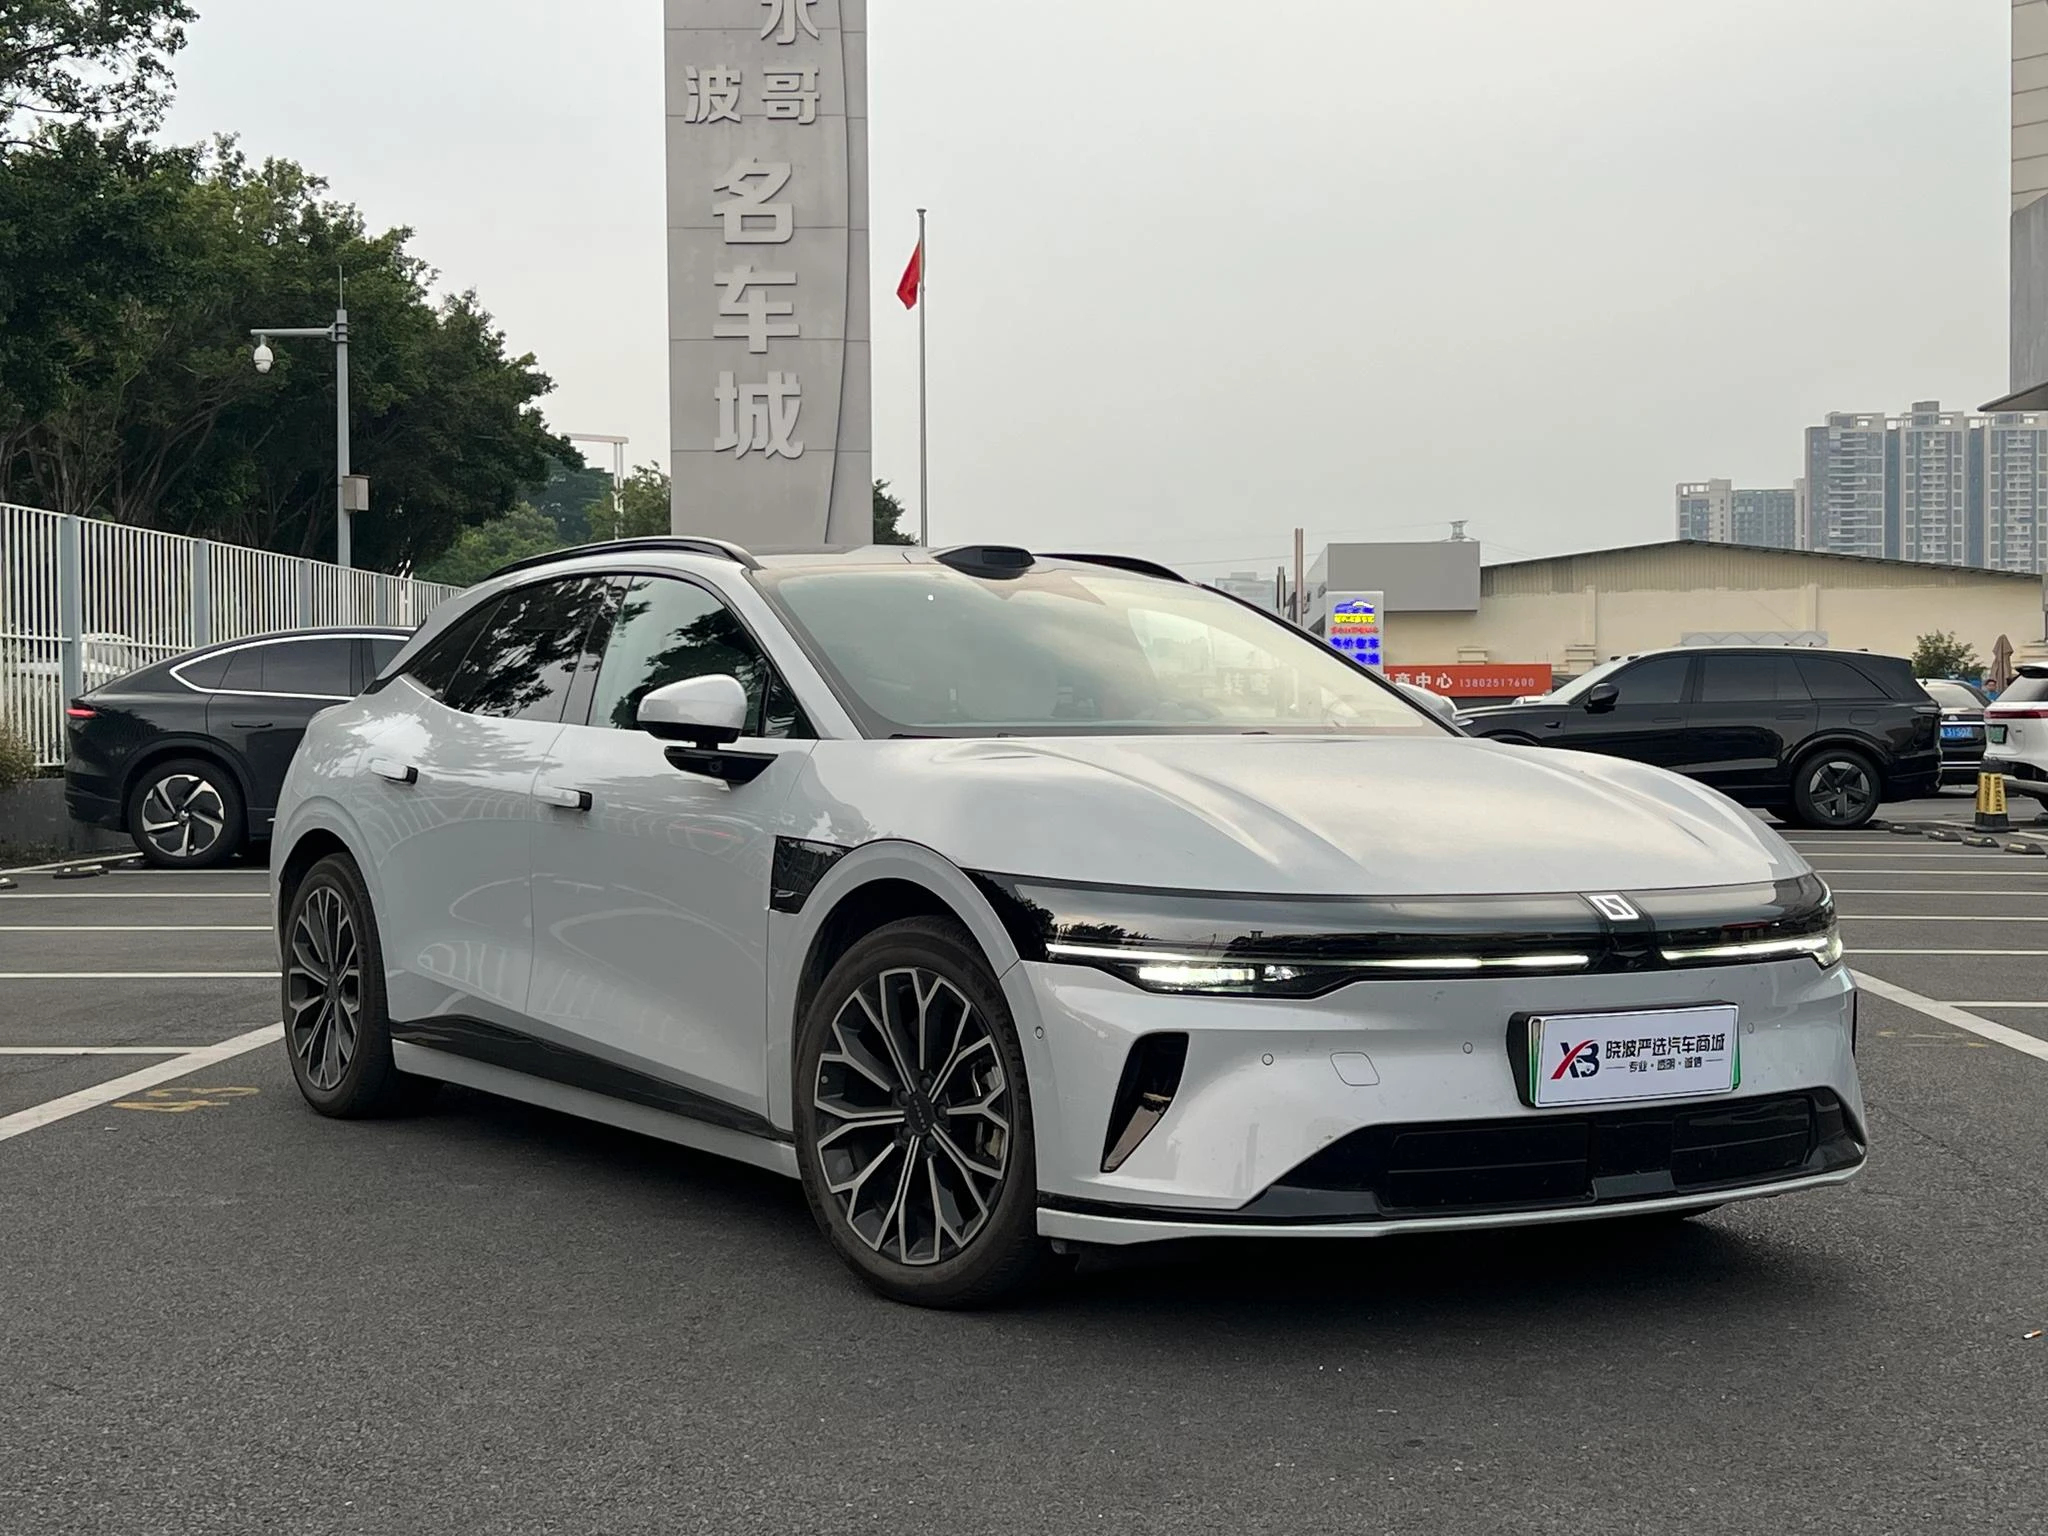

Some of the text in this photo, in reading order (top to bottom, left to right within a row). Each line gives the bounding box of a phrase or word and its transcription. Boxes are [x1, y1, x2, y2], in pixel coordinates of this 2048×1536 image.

[684, 64, 821, 125] 波哥
[712, 158, 804, 460] 名车城
[1606, 1033, 1726, 1060] 晓波严选汽车商城
